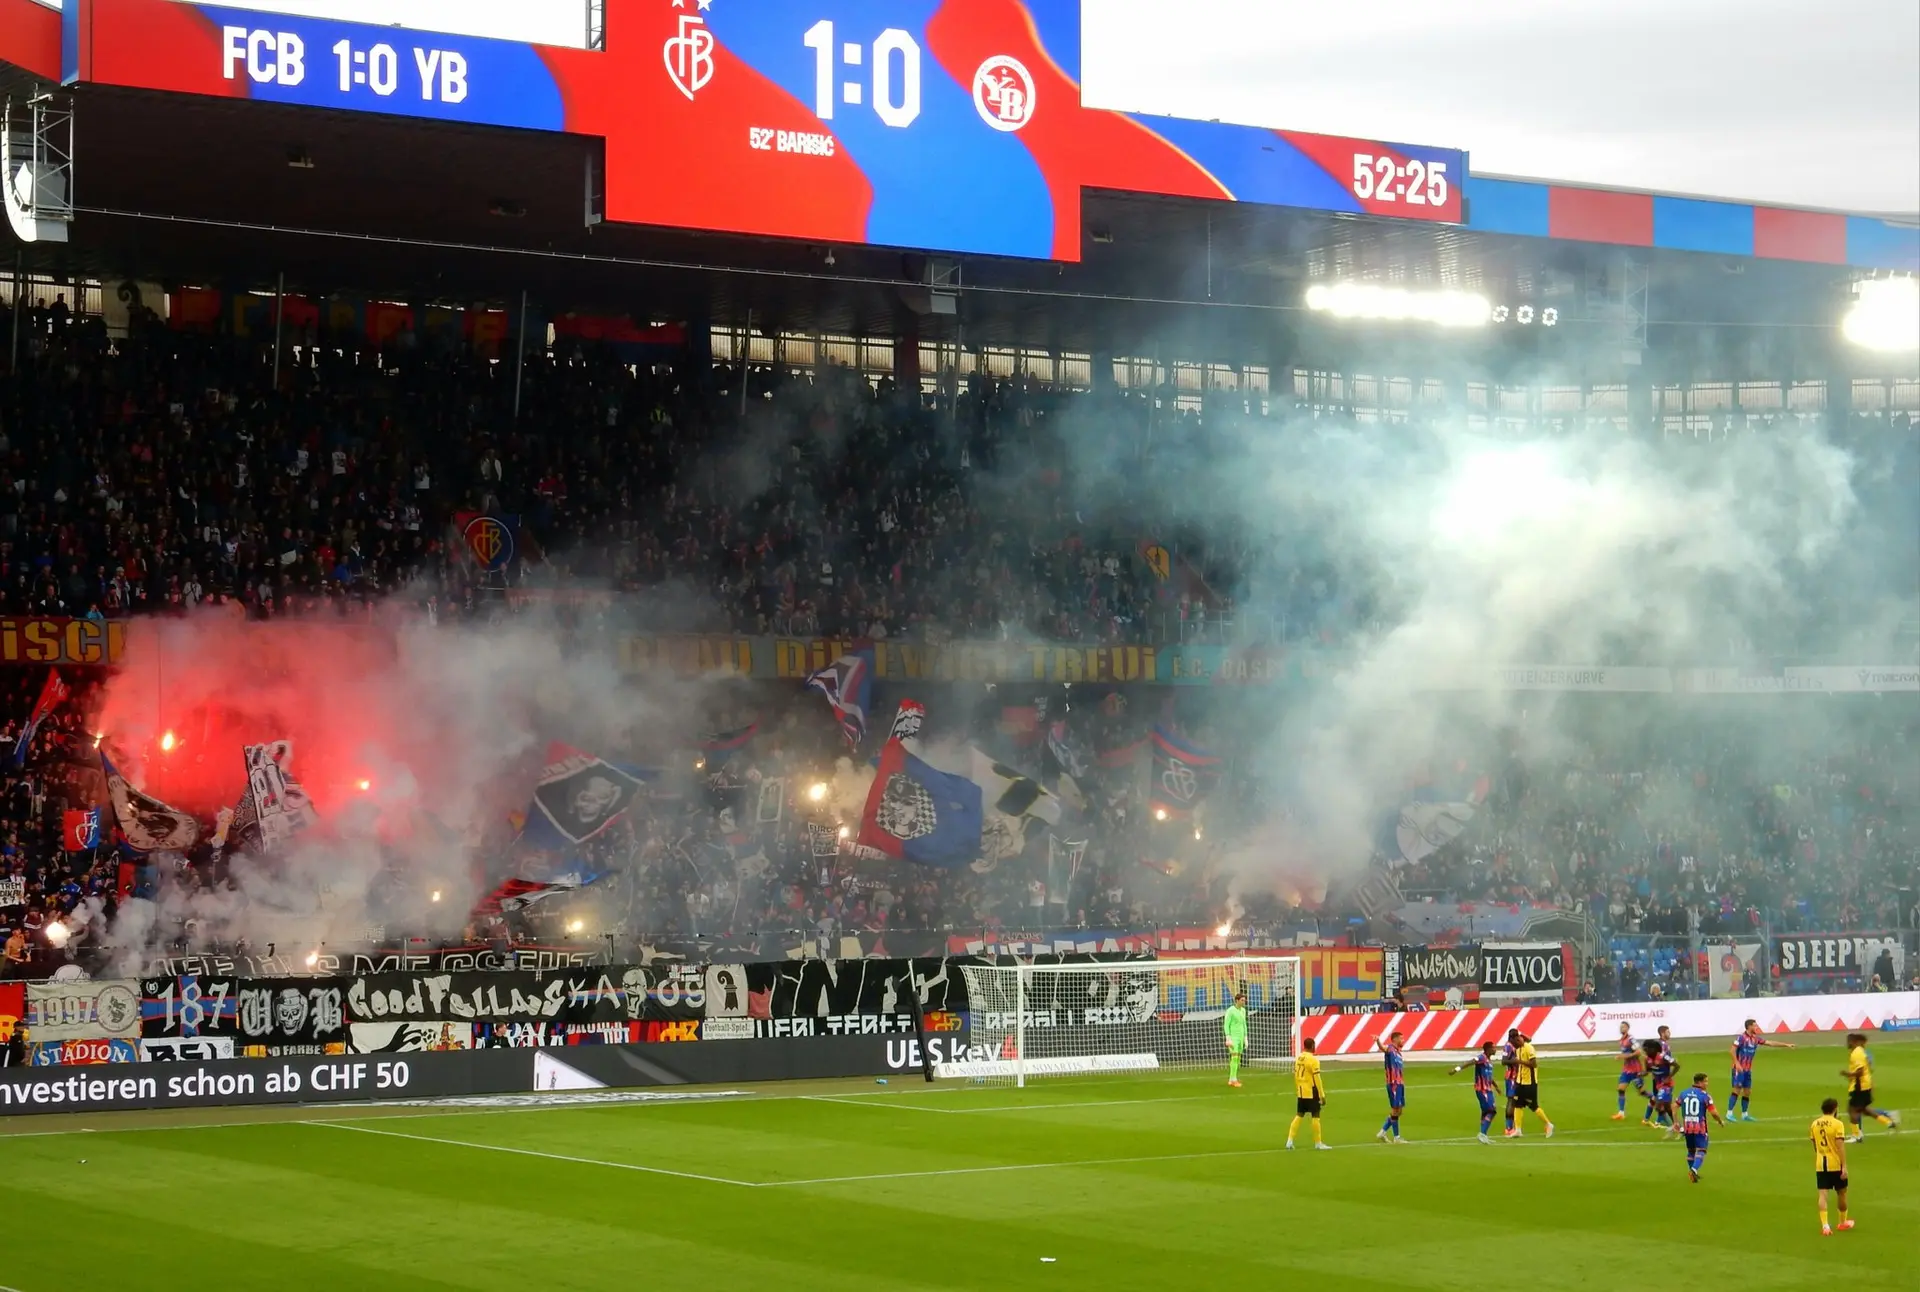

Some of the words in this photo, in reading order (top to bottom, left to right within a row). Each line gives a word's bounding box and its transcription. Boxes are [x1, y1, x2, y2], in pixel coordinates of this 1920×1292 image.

[223, 25, 305, 86] FCB
[333, 39, 398, 96] 1:0
[413, 47, 468, 104] YB
[803, 19, 921, 129] 1:0
[1353, 152, 1449, 208] 52:25
[1484, 954, 1562, 985] HAVOC
[34, 996, 94, 1028] 1997
[157, 982, 230, 1033] 187
[37, 1043, 129, 1067] STADION
[169, 1068, 255, 1098] schon
[265, 1065, 301, 1094] ab
[311, 1064, 368, 1092] CHF
[377, 1061, 409, 1088] 50
[1683, 1096, 1700, 1116] 10
[1819, 1128, 1828, 1147] 3
